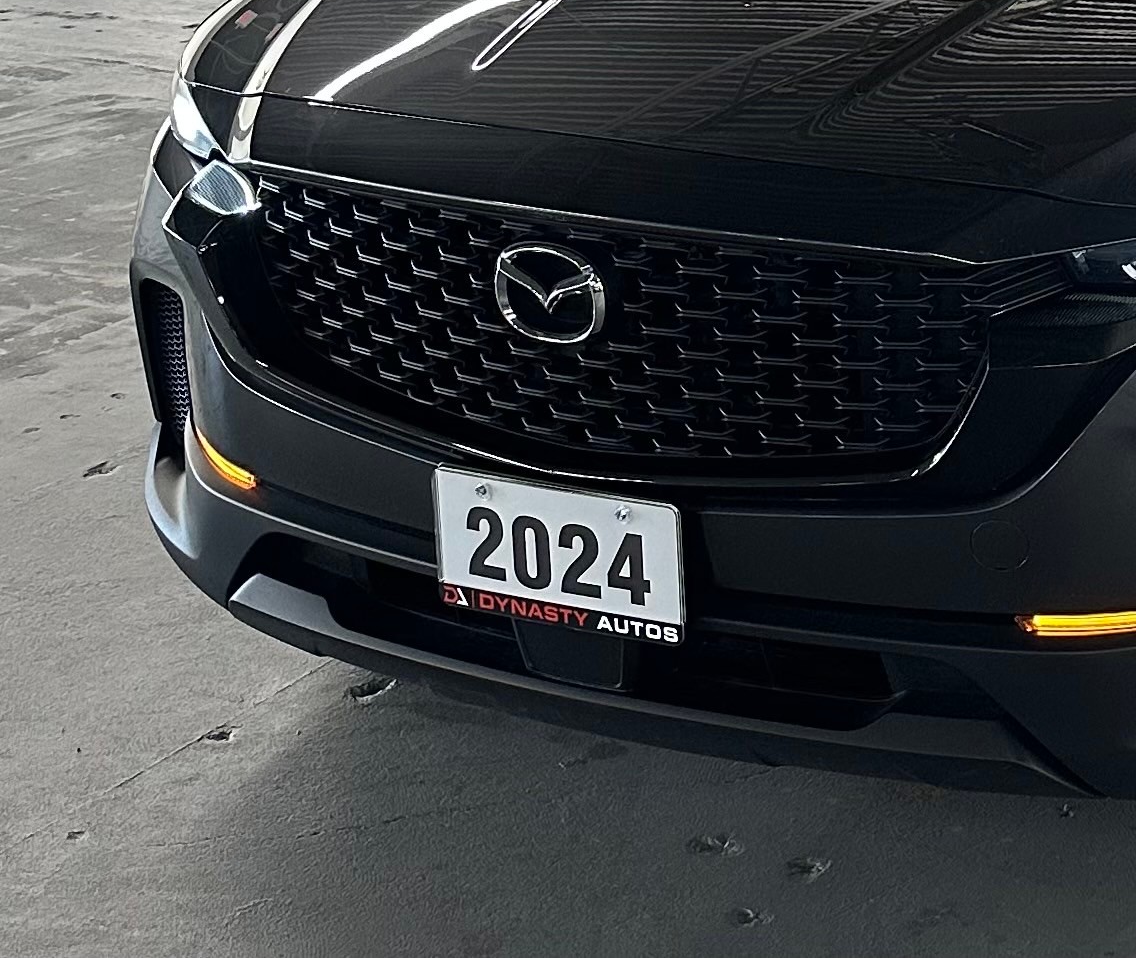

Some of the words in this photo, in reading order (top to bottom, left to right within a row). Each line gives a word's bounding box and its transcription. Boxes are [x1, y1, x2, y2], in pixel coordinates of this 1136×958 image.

[466, 506, 651, 607] 2024
[478, 592, 589, 627] DYNASTY
[596, 615, 679, 643] AUTOS
